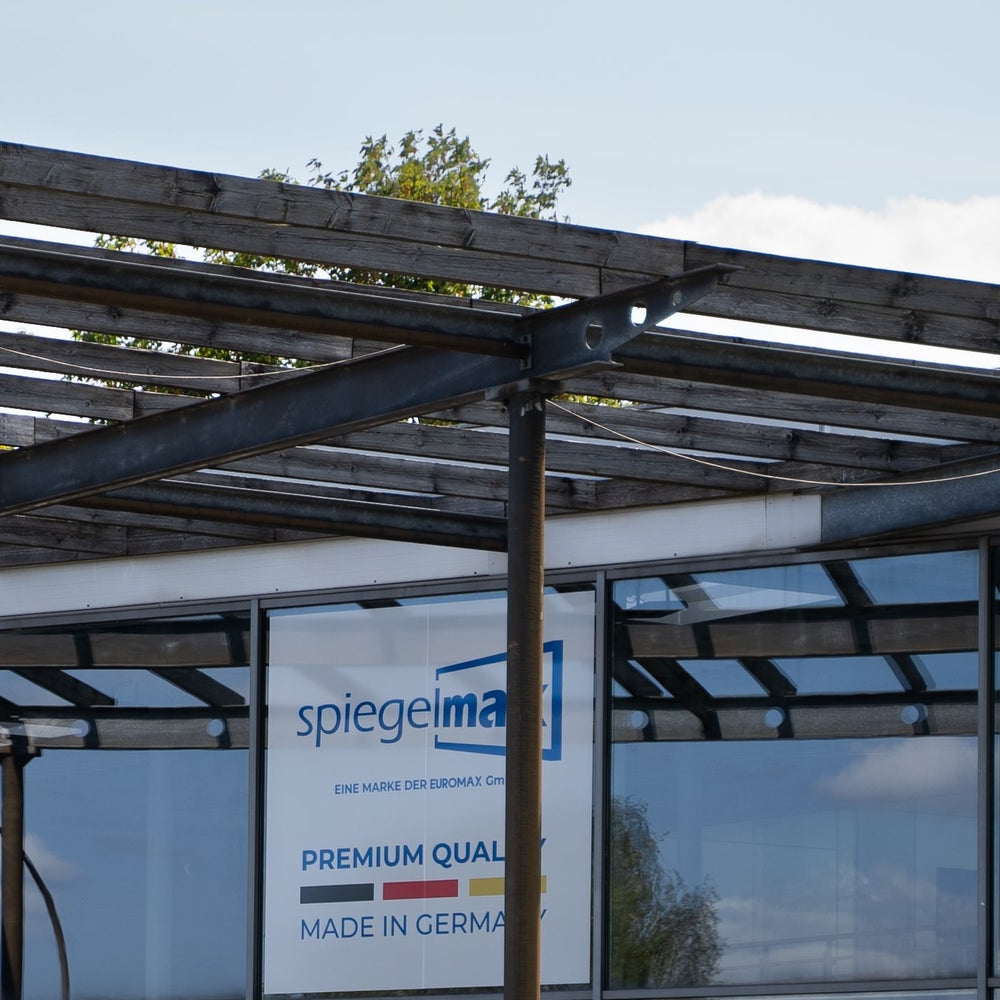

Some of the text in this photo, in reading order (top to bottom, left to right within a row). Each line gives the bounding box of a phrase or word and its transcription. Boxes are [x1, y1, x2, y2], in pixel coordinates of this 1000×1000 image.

[334, 775, 504, 795] EINE MARKE DER EUROMAX Gm
[301, 838, 546, 871] PREMIUM QUAL
[300, 909, 547, 941] MADE IN GERMA
